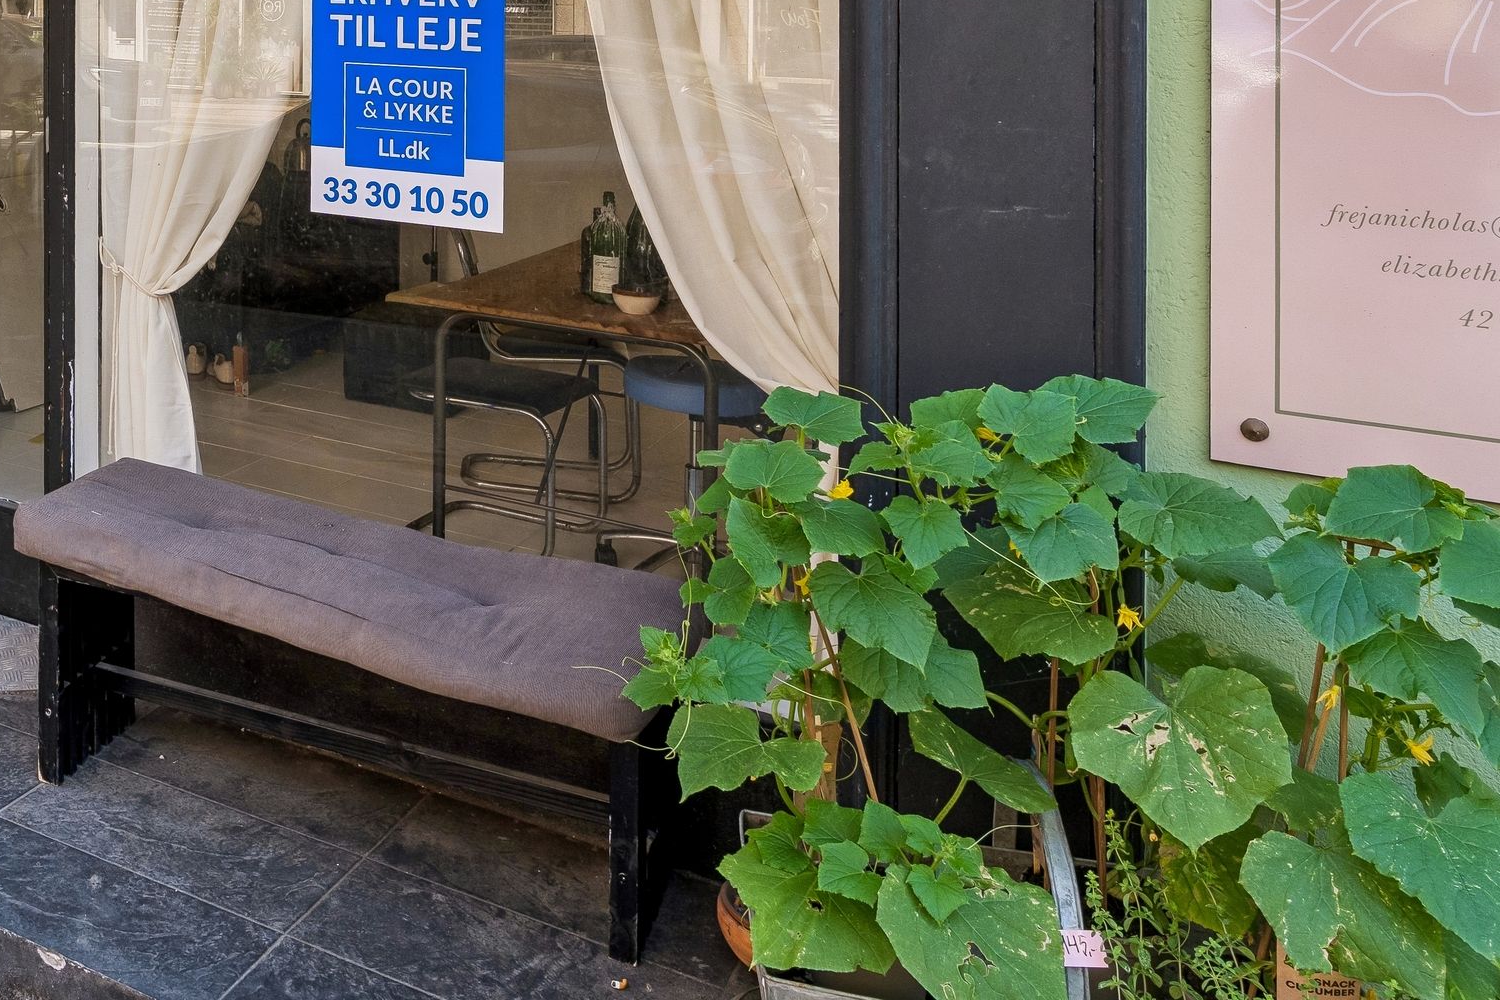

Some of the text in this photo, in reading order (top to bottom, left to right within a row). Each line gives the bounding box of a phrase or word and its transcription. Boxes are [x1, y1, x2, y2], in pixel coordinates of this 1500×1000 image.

[329, 14, 482, 52] TIL LEJE
[355, 76, 454, 100] LA COUR
[363, 100, 454, 124] & LYKKE
[378, 137, 430, 161] LL.dk
[323, 176, 489, 219] 33 30 10 50
[1459, 308, 1494, 330] 42
[1285, 980, 1355, 996] CUUMBER
[1314, 978, 1357, 988] SNACK
